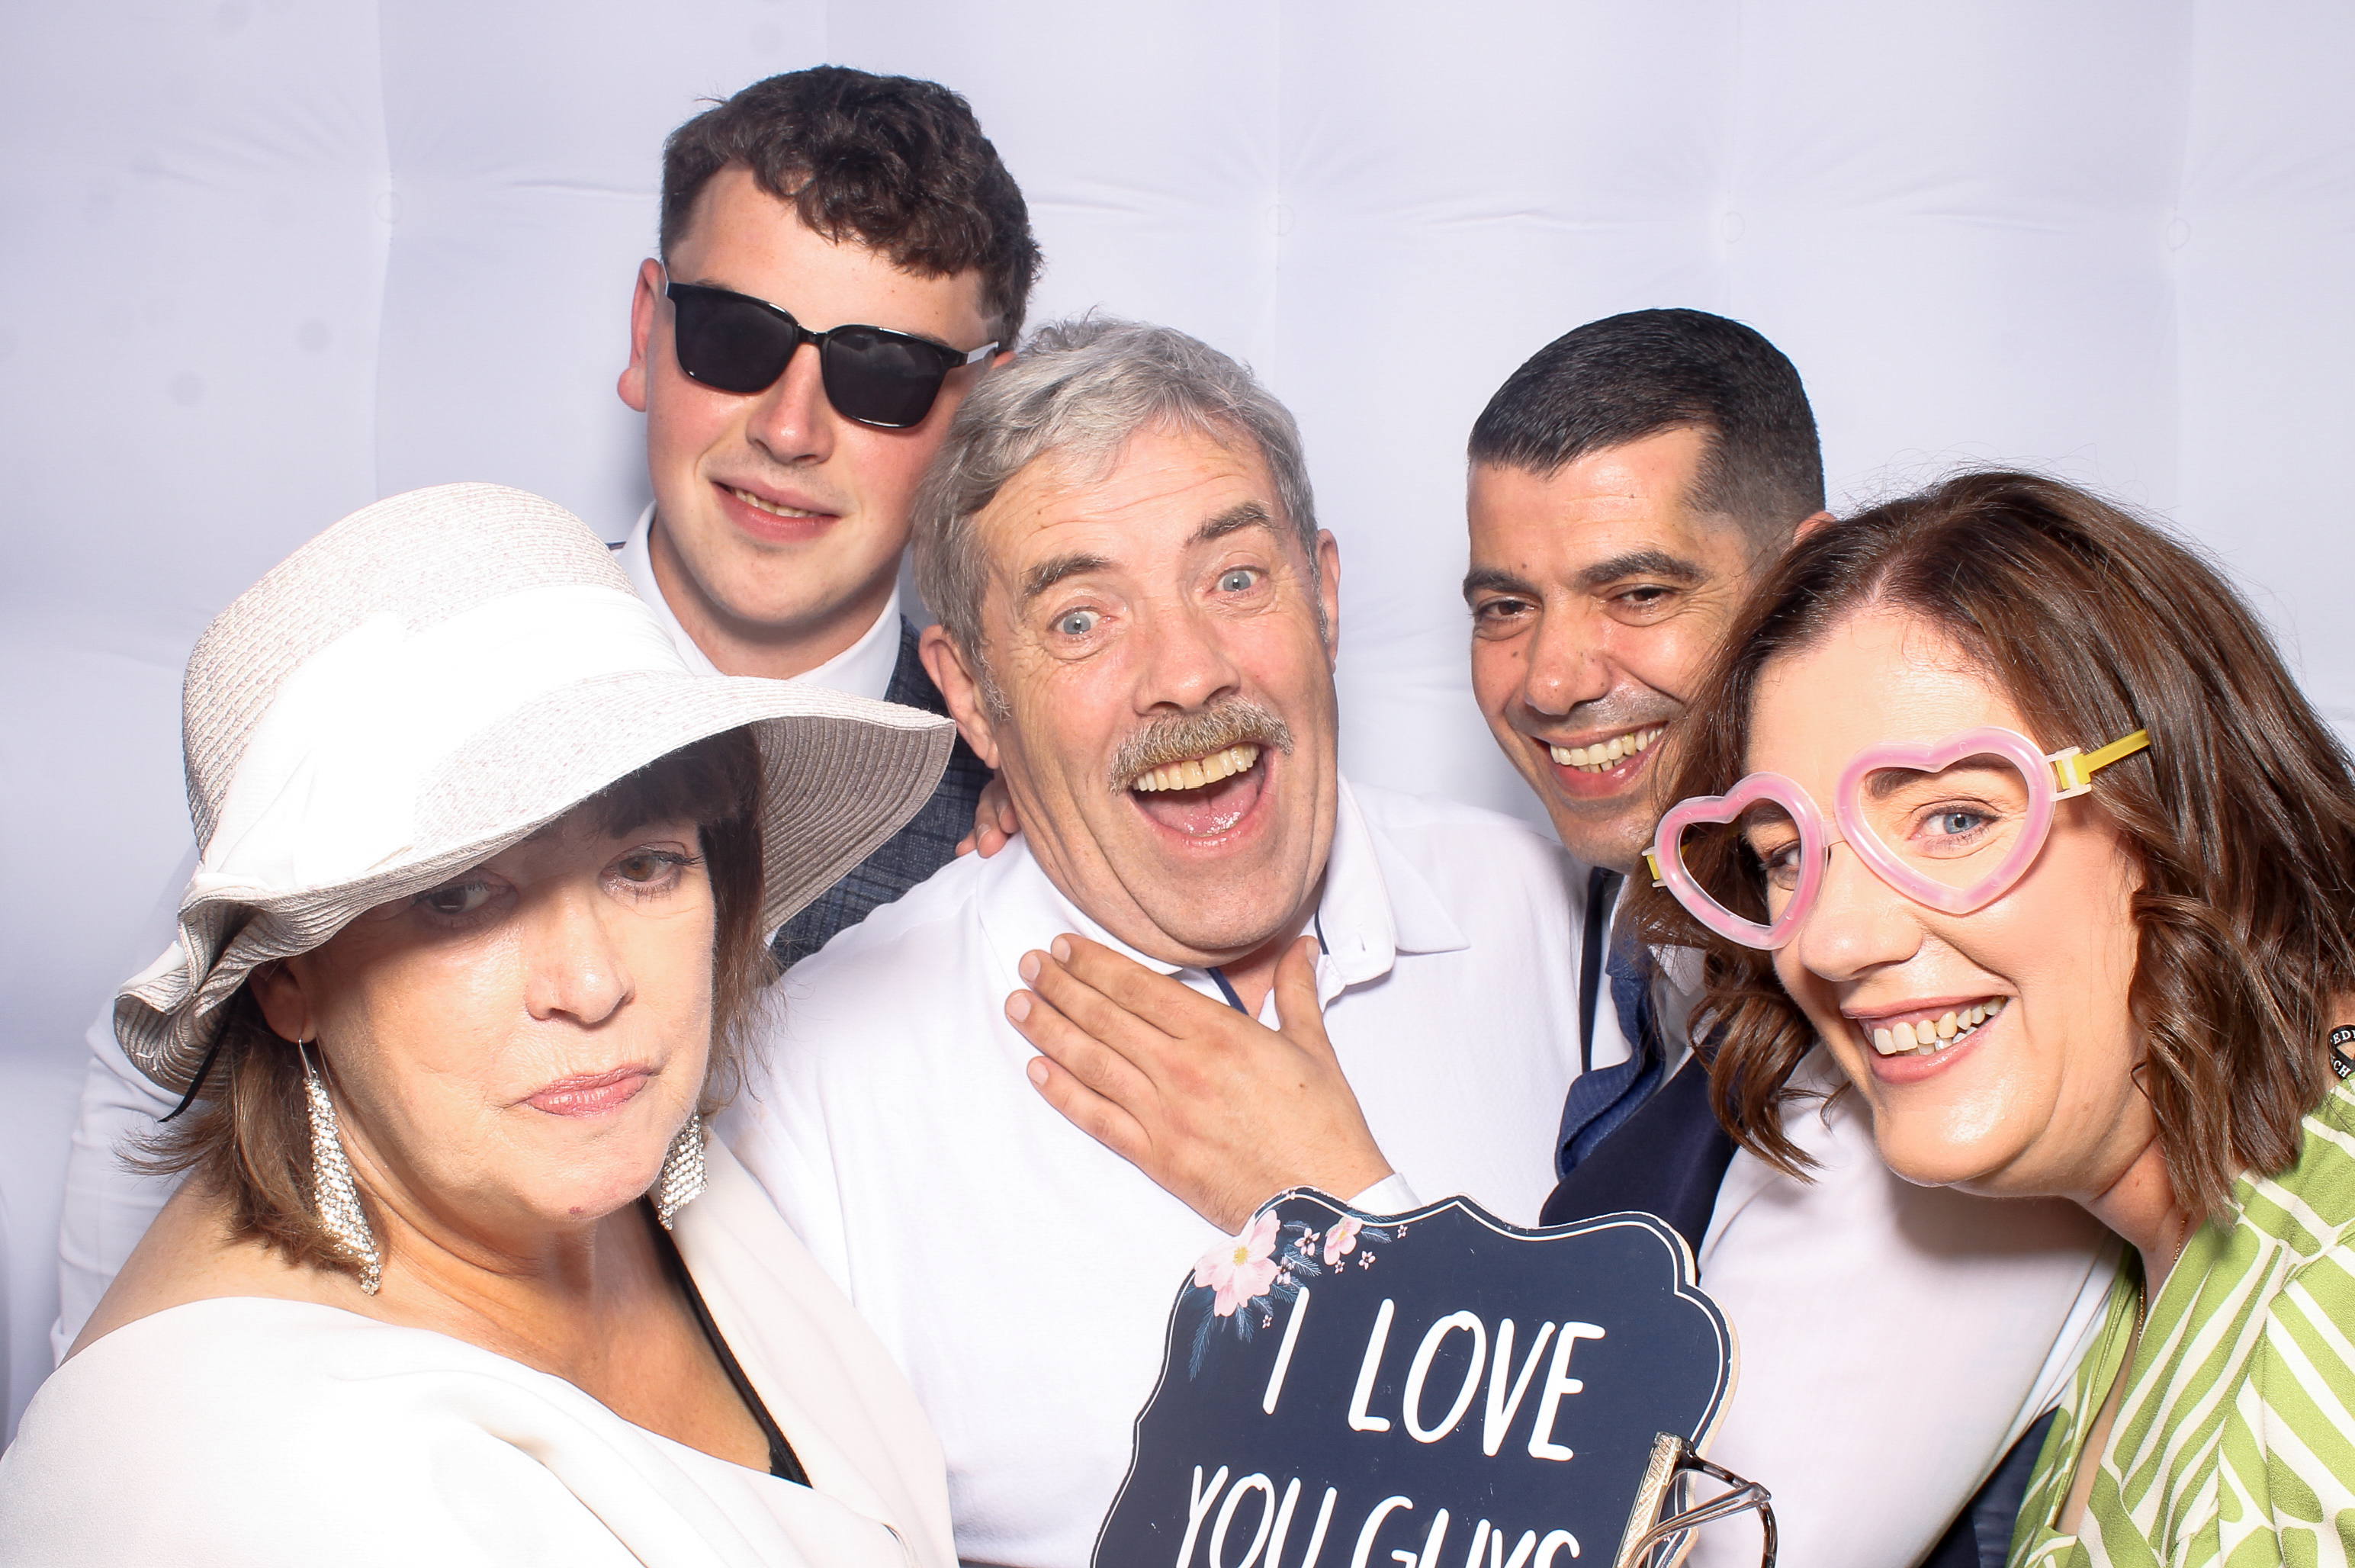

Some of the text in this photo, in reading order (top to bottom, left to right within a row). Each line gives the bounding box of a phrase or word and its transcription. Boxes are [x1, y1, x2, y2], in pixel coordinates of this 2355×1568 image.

[1261, 1286, 1606, 1461] I LOVE
[1175, 1464, 1338, 1568] YOU
